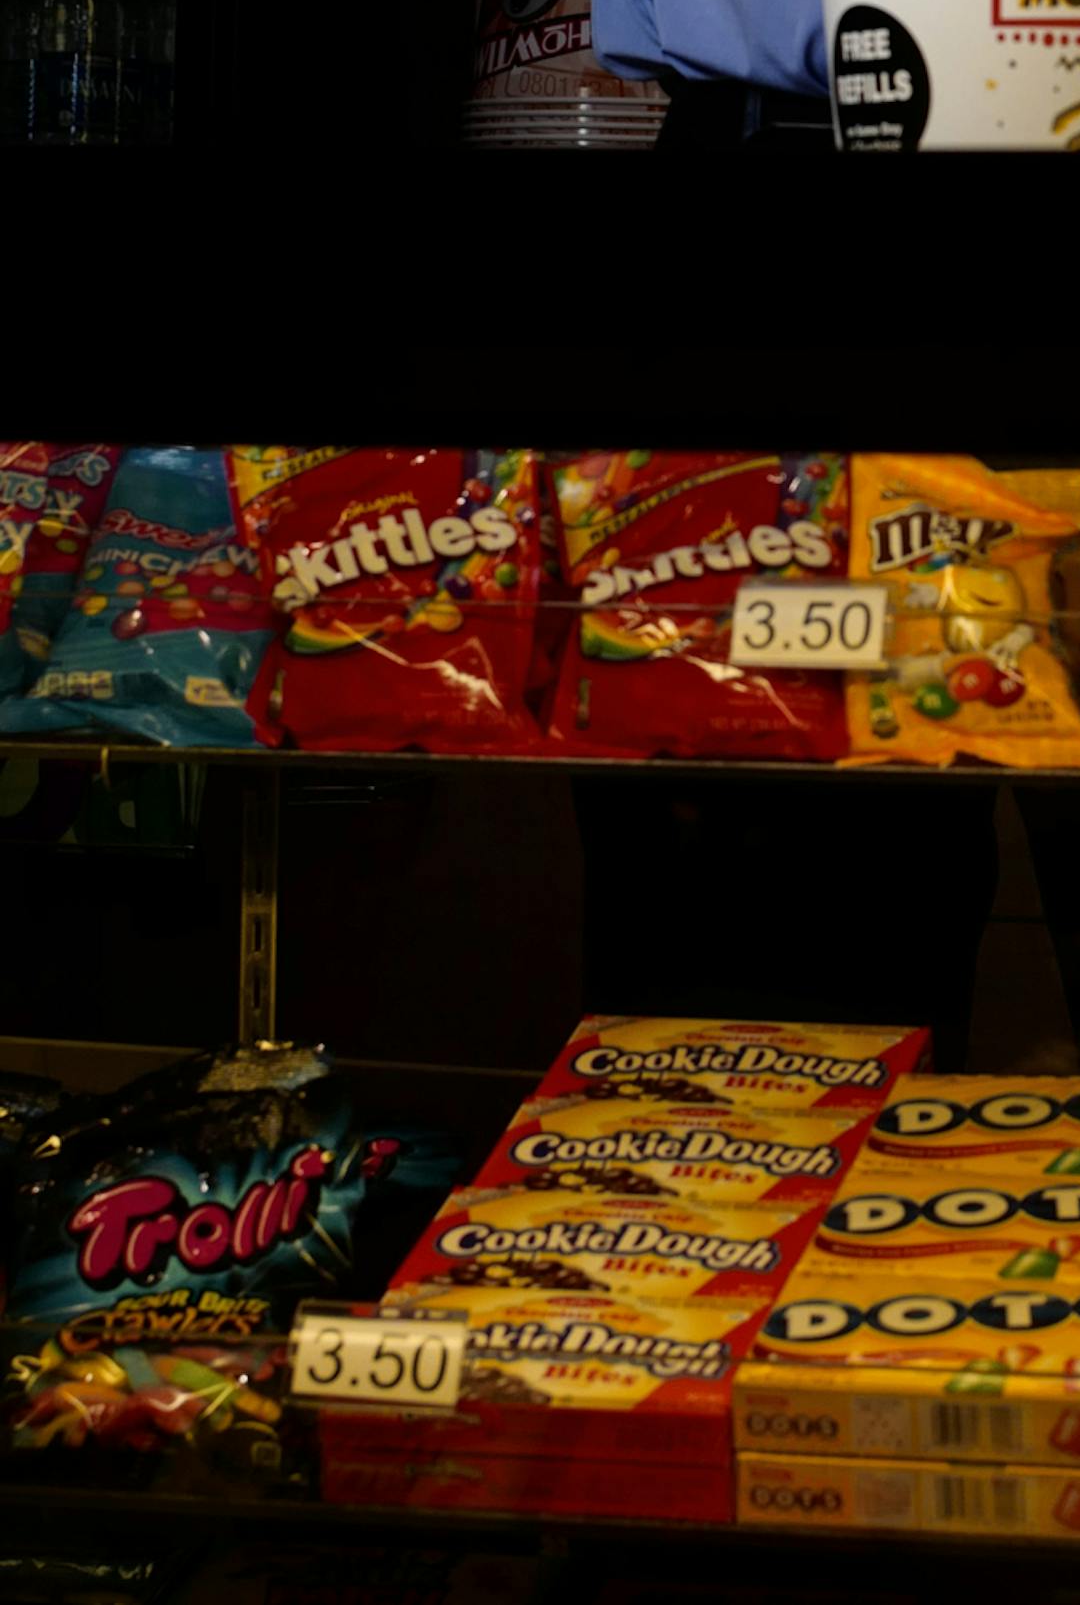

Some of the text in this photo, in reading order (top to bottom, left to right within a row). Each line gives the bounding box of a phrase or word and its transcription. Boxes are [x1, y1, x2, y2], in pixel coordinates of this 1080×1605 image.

[839, 27, 893, 64] FREE
[741, 599, 873, 652] 3.50
[66, 1144, 333, 1284] Trolli
[308, 1327, 448, 1392] 3.50
